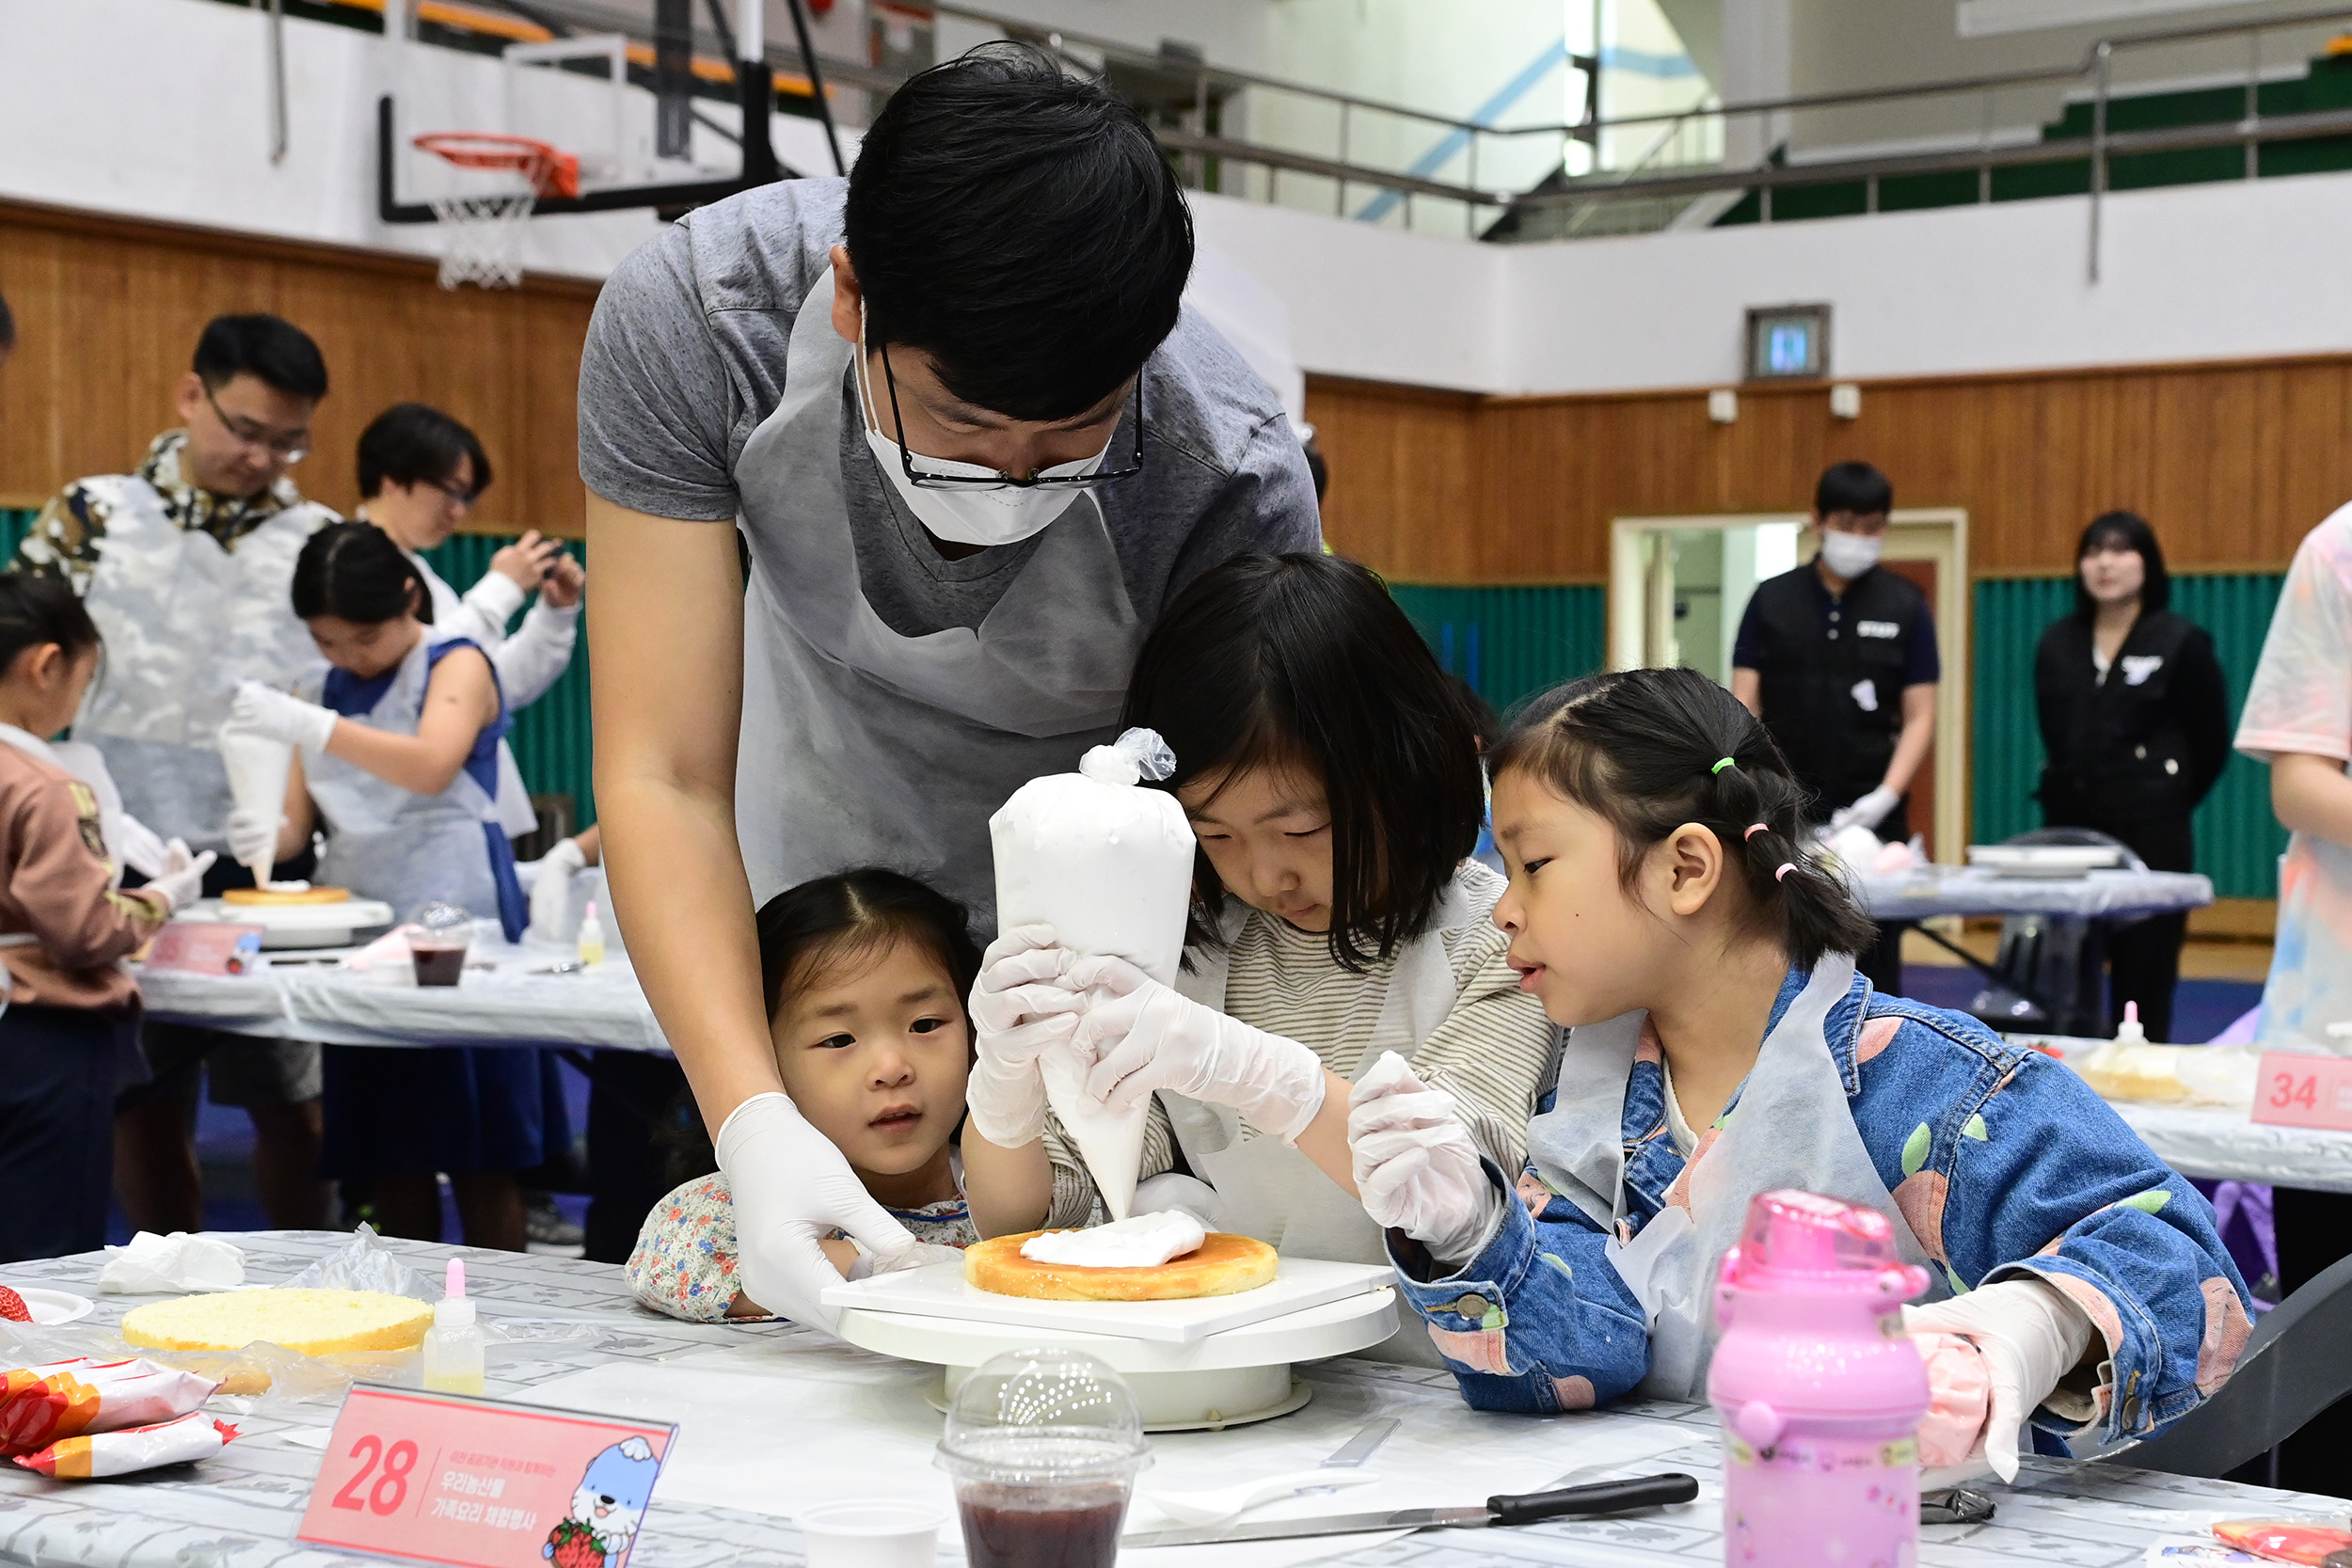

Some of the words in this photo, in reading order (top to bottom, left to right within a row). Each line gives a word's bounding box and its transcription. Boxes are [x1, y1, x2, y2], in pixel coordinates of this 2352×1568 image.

[2269, 1071, 2317, 1111] 34
[332, 1434, 419, 1516] 28
[441, 1470, 506, 1498] 우리농산물
[431, 1497, 485, 1523] 가족요리
[483, 1505, 537, 1531] 체험행사
